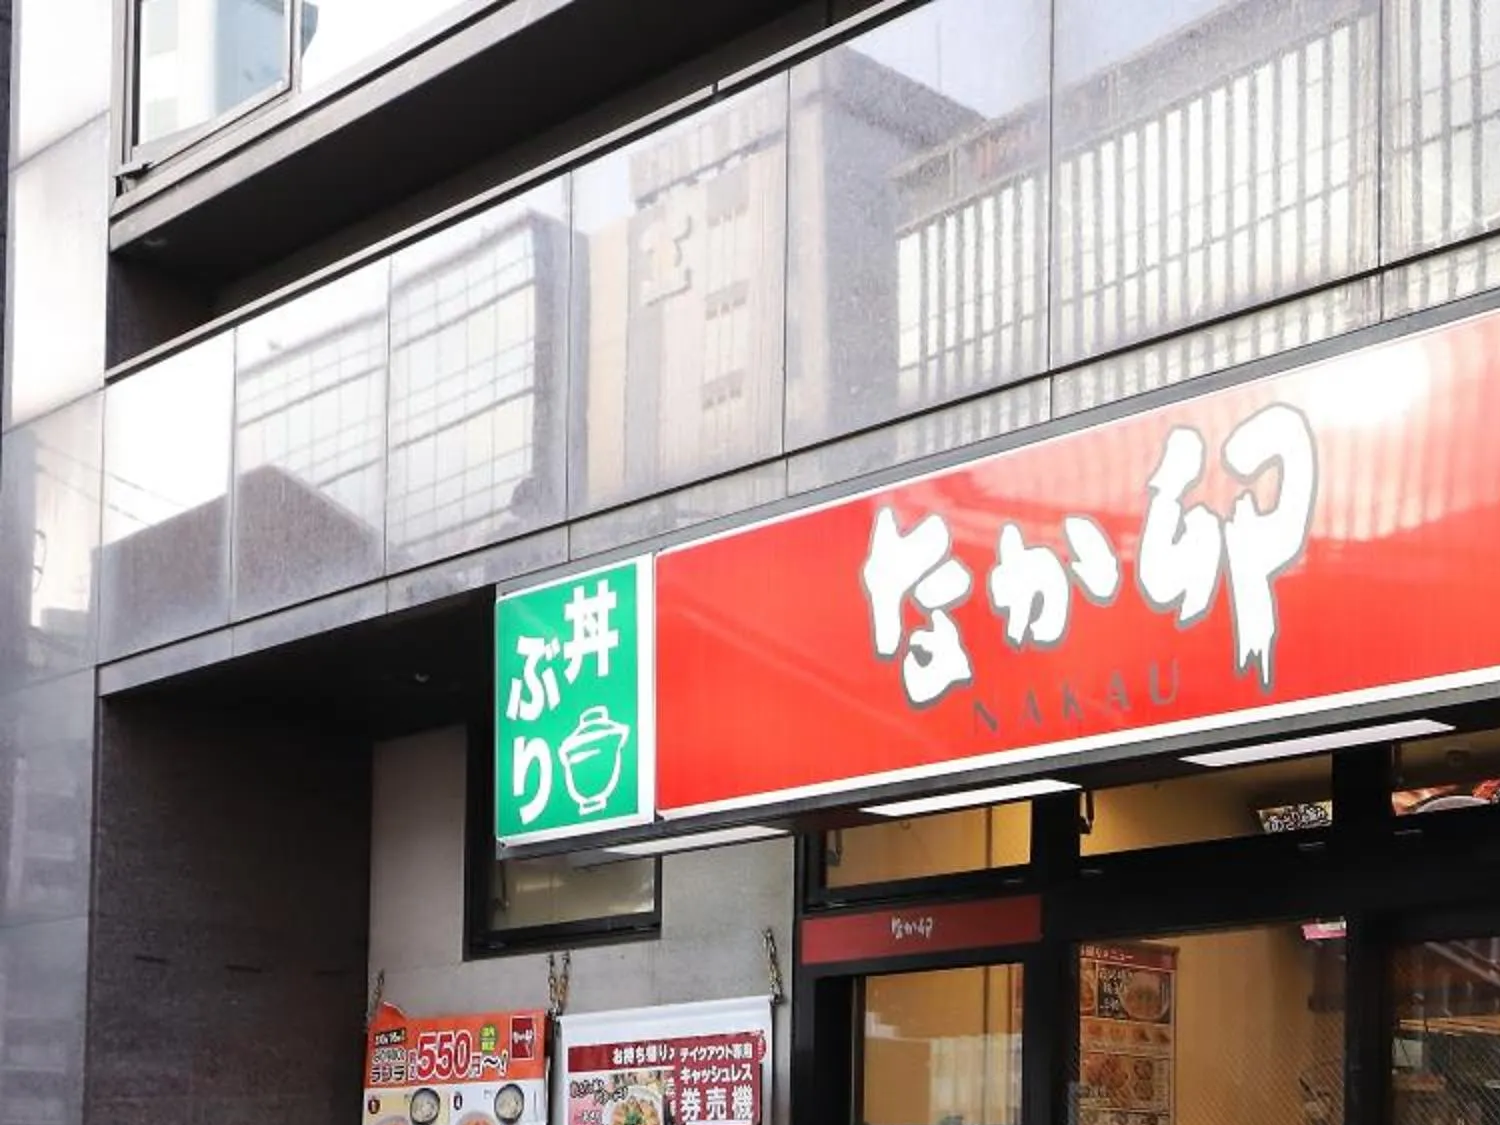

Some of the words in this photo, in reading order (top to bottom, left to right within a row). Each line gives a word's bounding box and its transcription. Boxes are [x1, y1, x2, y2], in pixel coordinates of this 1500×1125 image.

[861, 402, 1319, 710] なか卯
[972, 660, 1181, 734] NAKAU
[680, 1064, 753, 1085] キャッシュレス
[681, 1085, 753, 1121] 券売機
